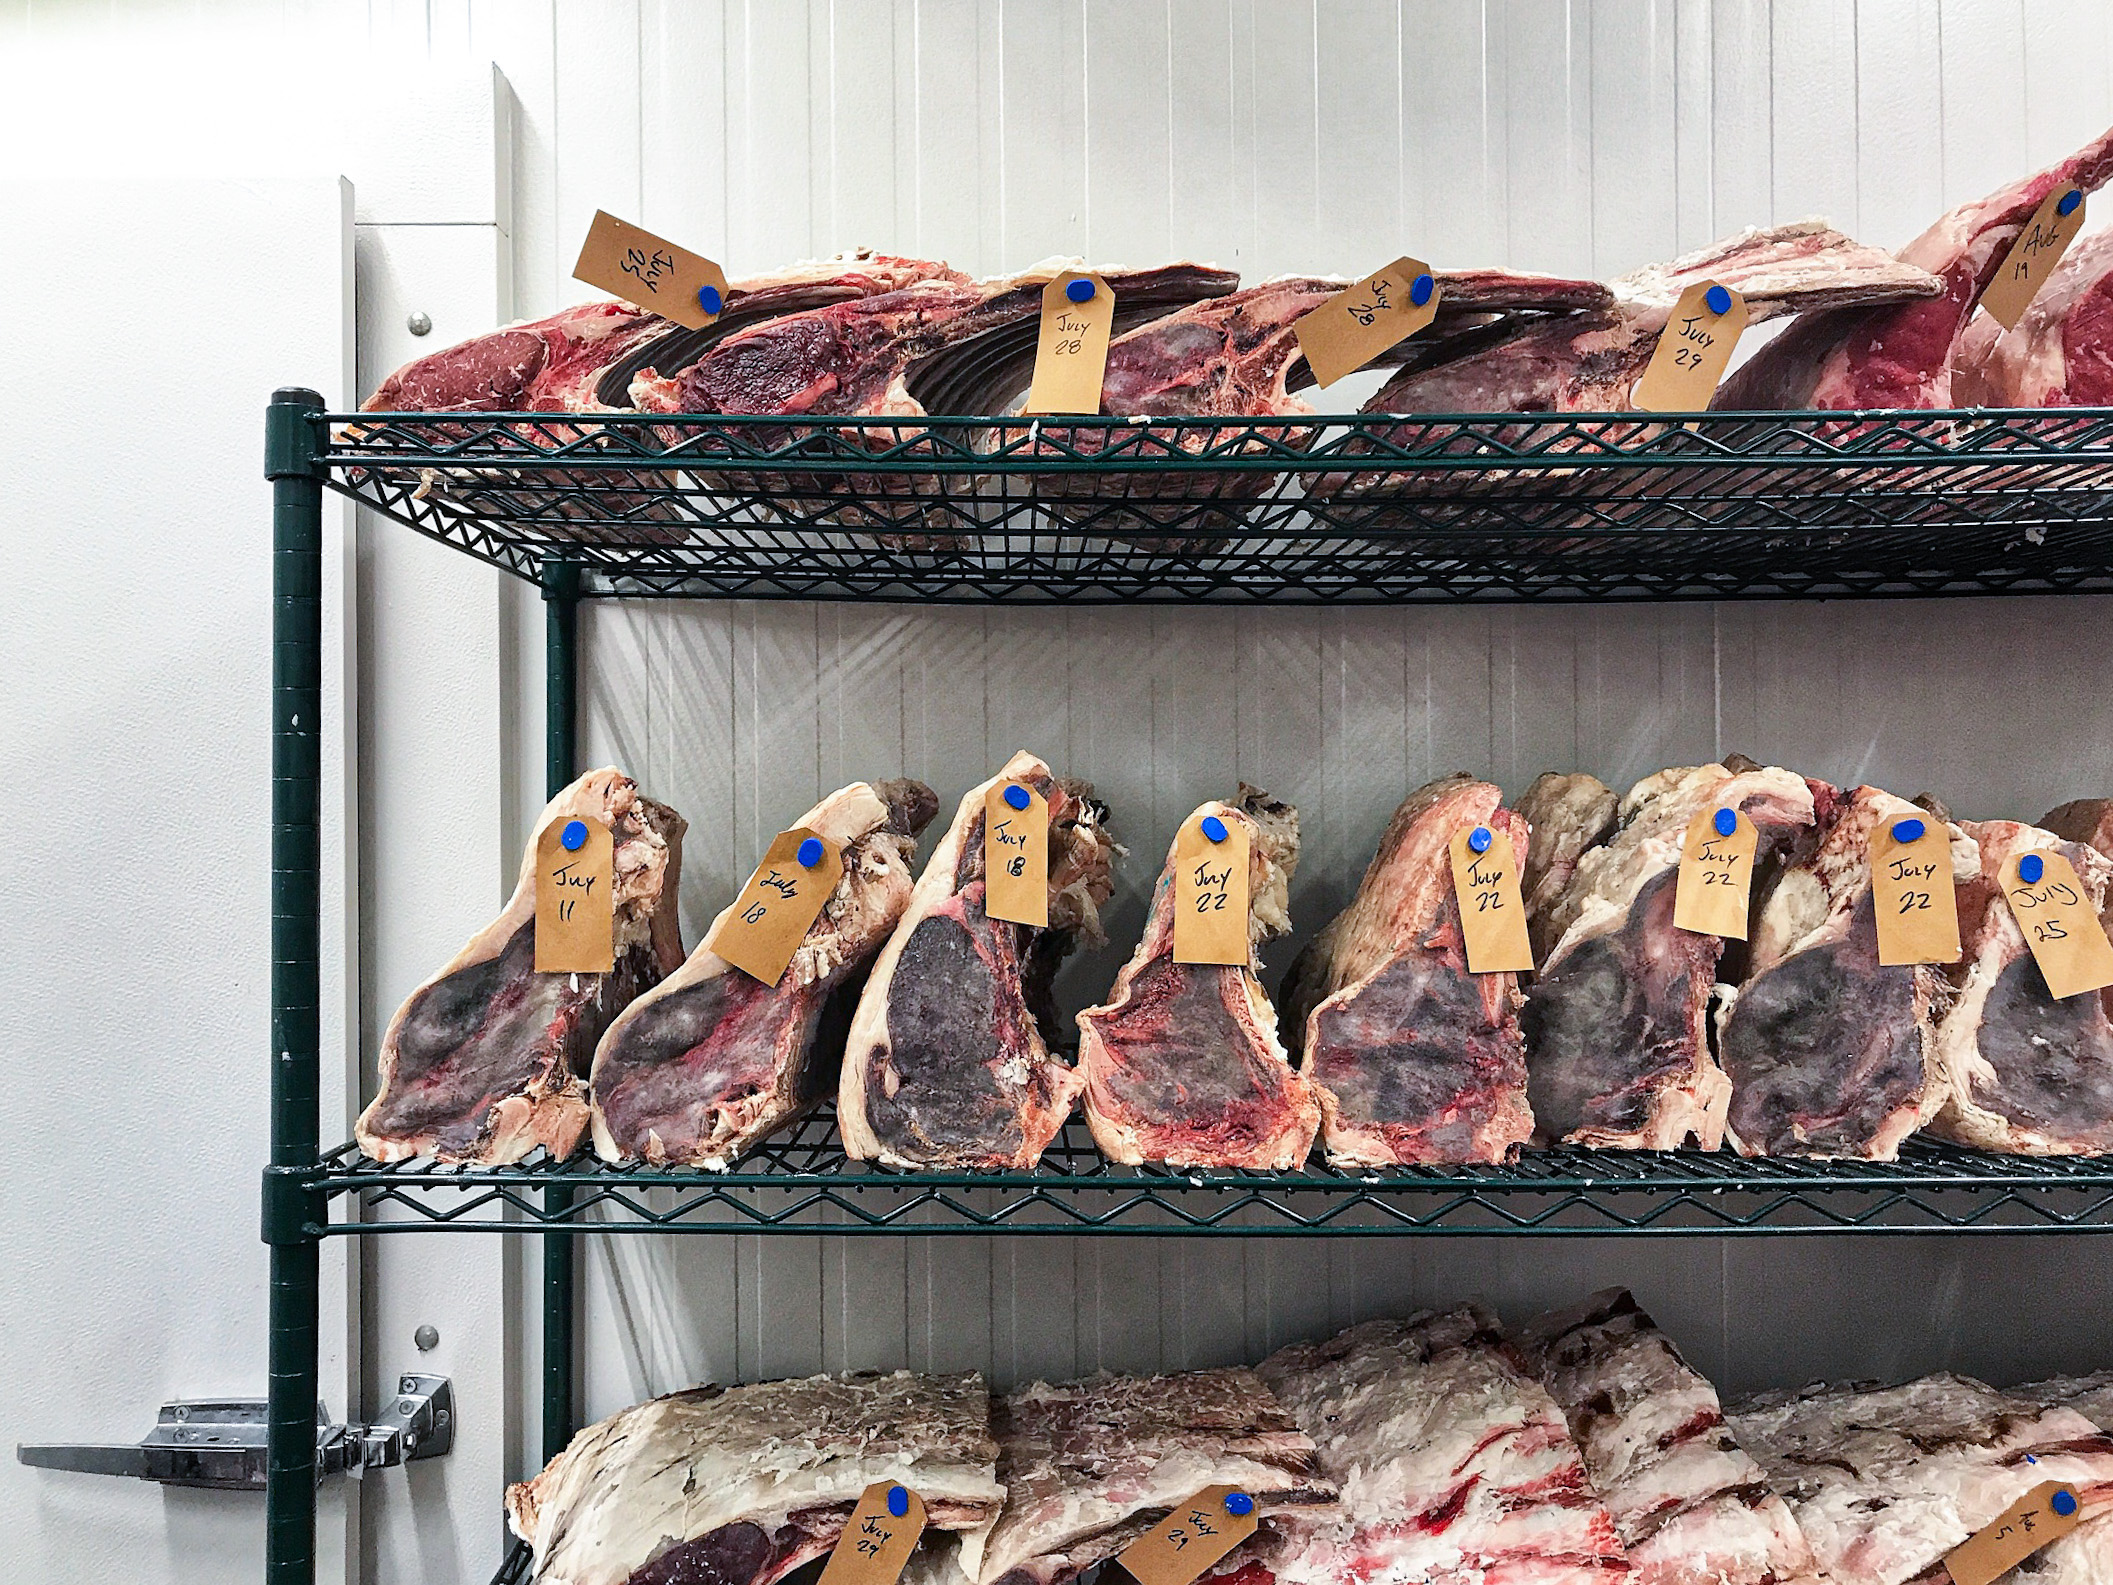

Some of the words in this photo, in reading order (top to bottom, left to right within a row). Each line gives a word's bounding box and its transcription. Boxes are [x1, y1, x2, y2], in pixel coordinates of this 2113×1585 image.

[620, 247, 645, 279] 25
[2014, 262, 2029, 281] 19
[1347, 303, 1375, 326] 28
[1054, 339, 1082, 356] 28
[1674, 348, 1703, 371] 29
[1006, 856, 1027, 877] 18
[1701, 870, 1739, 887] 22
[559, 900, 576, 922] 11
[740, 900, 767, 925] 18
[1195, 892, 1228, 913] 22
[1475, 891, 1505, 912] 22
[1898, 890, 1932, 914] 22
[2033, 920, 2068, 942] 25
[856, 1540, 880, 1559] 29
[1166, 1529, 1189, 1551] 29
